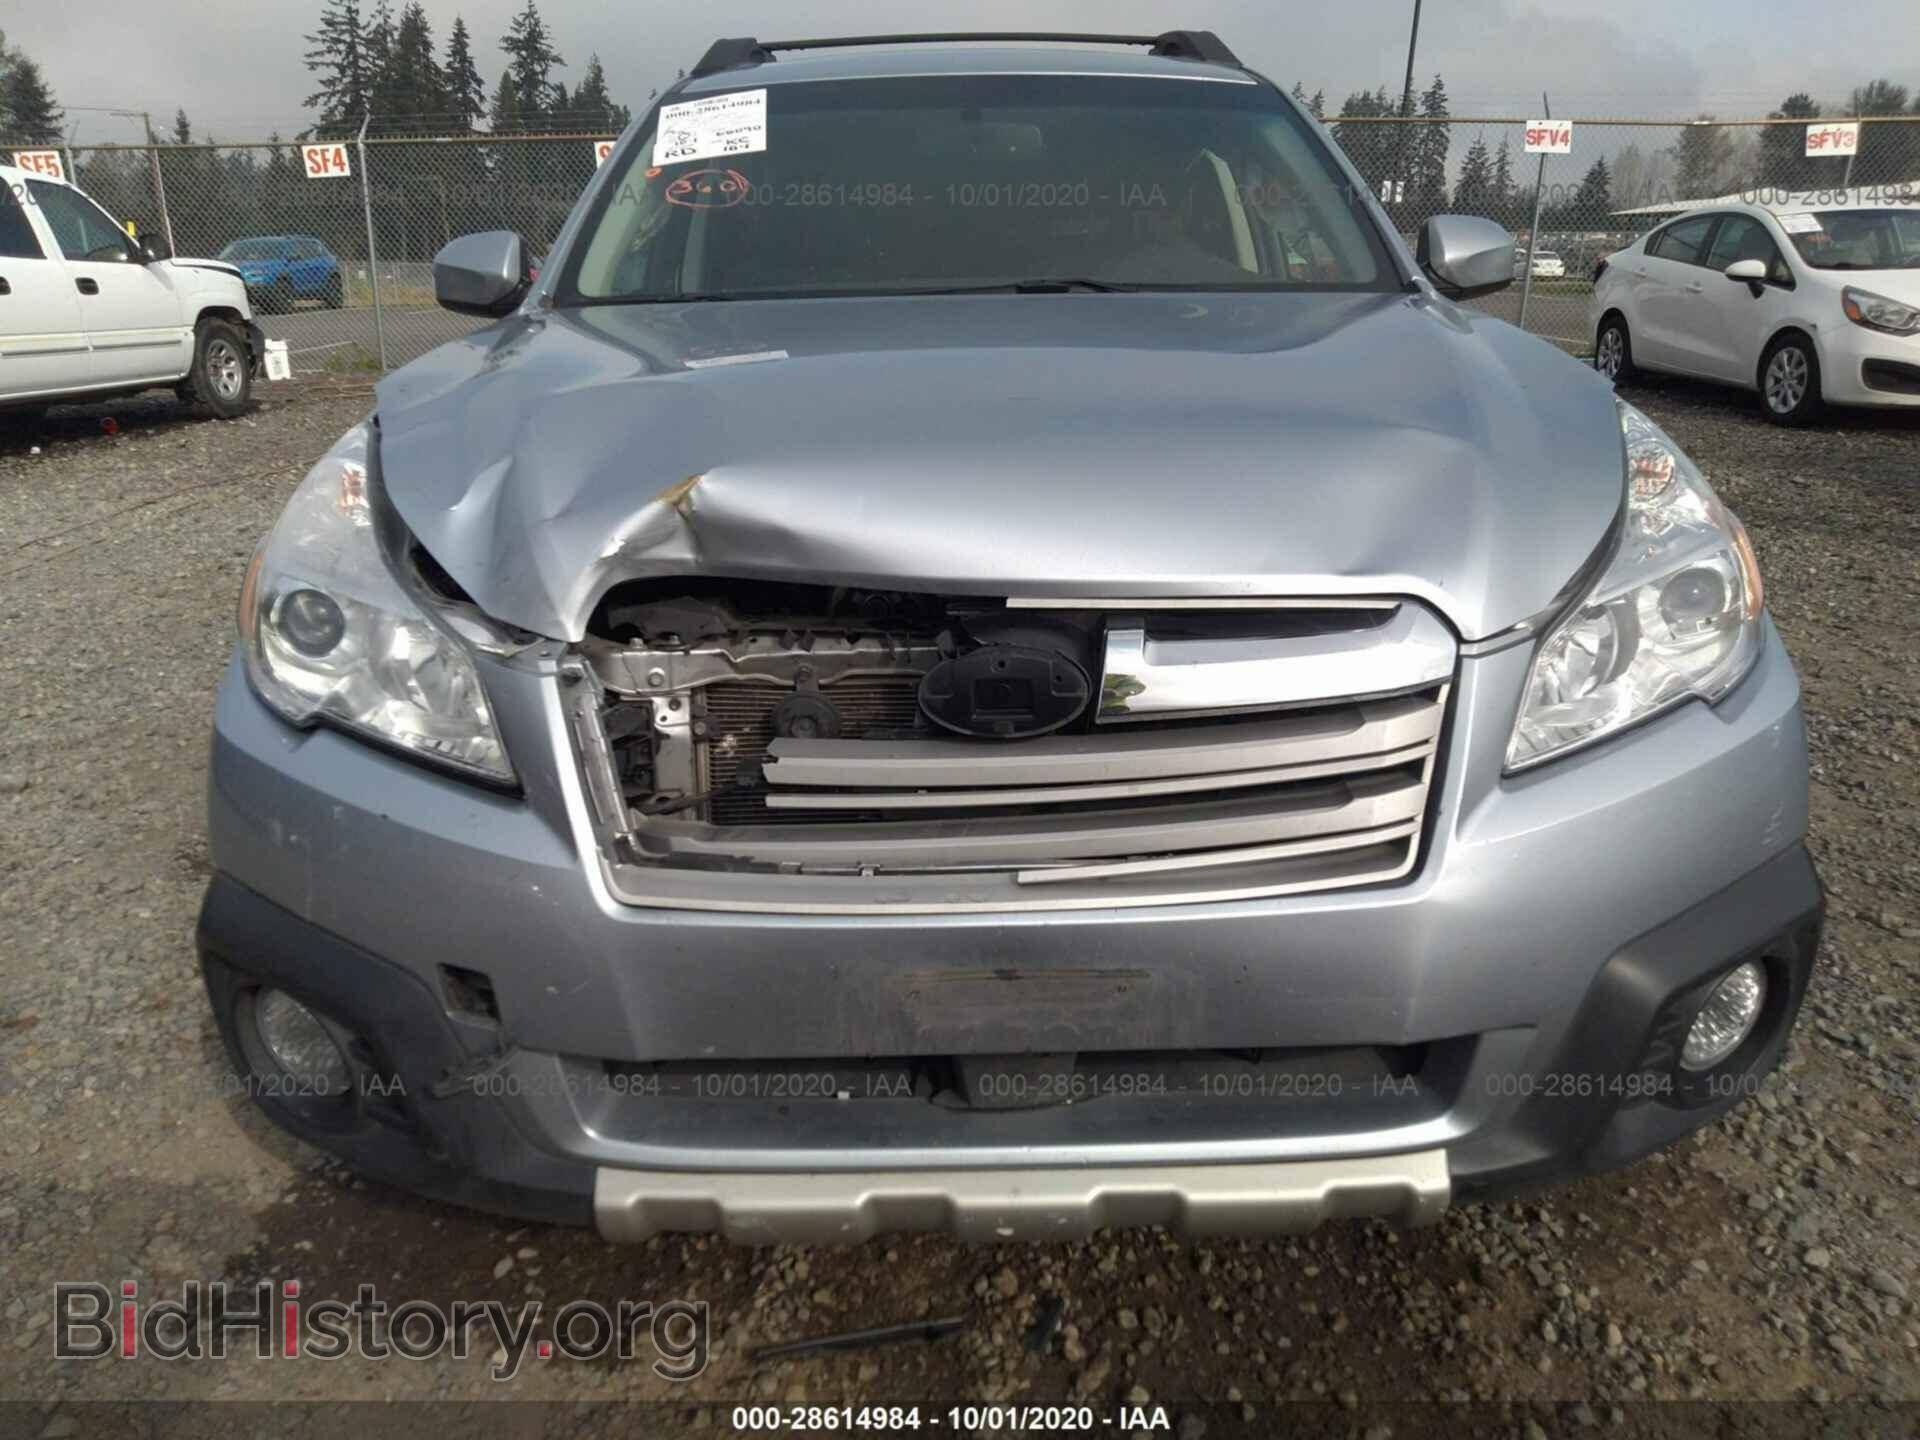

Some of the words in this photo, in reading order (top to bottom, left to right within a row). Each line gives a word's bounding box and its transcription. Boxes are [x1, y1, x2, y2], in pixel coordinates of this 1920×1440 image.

[1526, 129, 1569, 147] SFV4
[1807, 131, 1855, 149] SFV3
[19, 154, 61, 177] SF5
[306, 147, 346, 174] SF4
